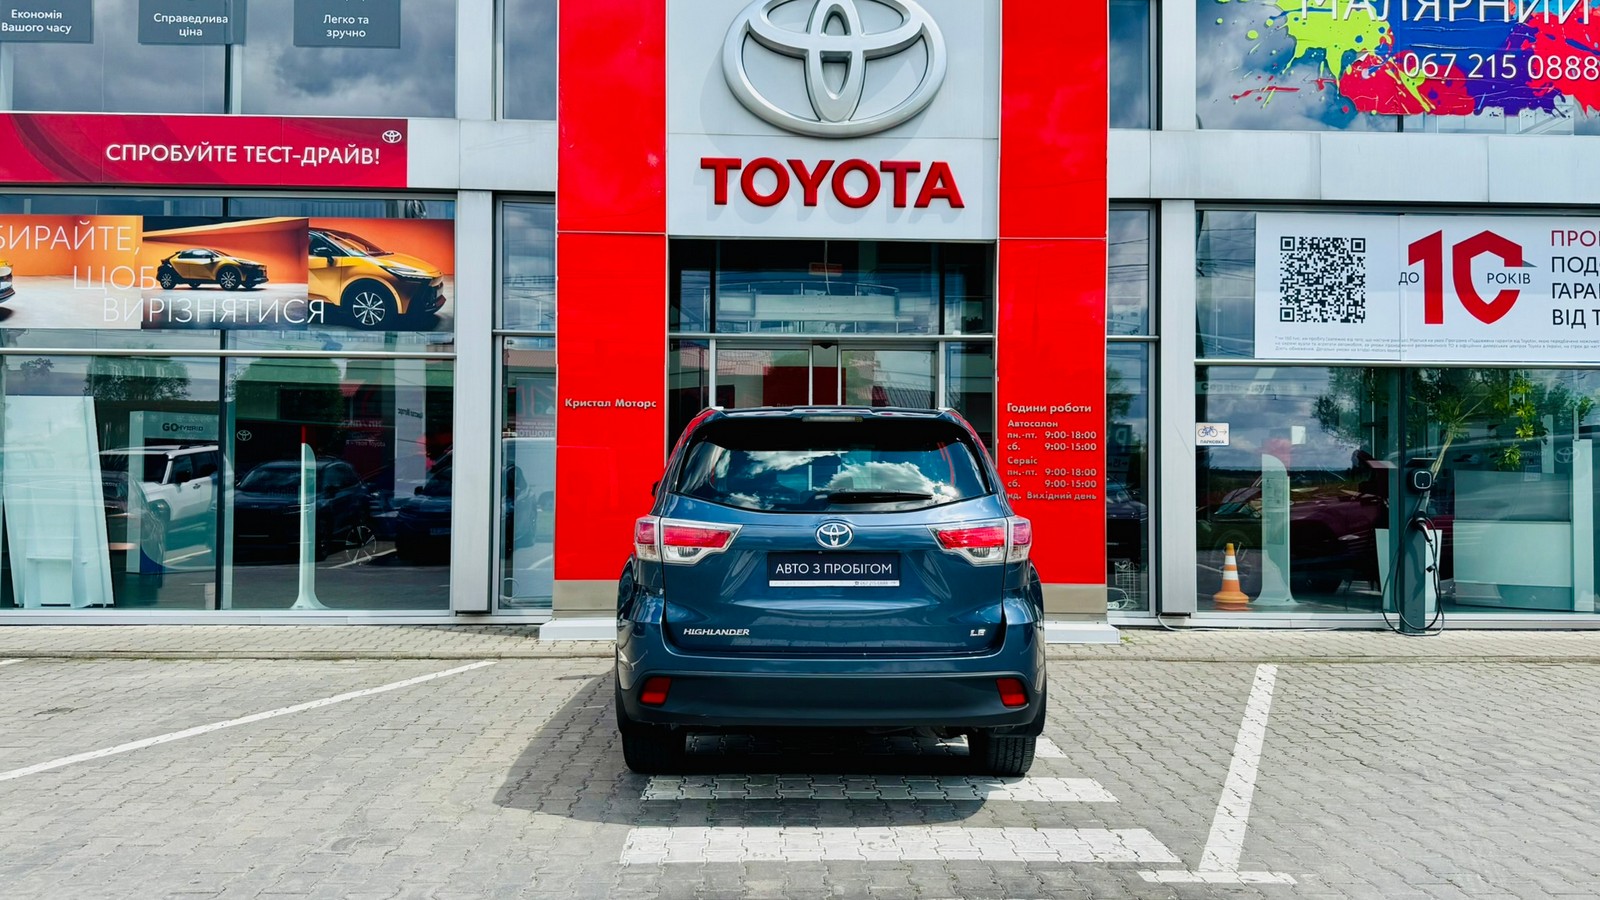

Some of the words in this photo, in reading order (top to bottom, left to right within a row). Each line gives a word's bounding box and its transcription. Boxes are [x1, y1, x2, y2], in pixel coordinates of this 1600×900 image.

[11, 9, 63, 20] Економія
[153, 12, 229, 25] Справедлива
[323, 14, 355, 25] Легко
[357, 16, 370, 25] та
[1, 22, 44, 33] Вашого
[47, 23, 72, 34] часу
[179, 27, 203, 38] ціна
[326, 29, 366, 39] зручно
[1402, 53, 1456, 79] 067
[1467, 54, 1517, 79] 215
[1527, 55, 1600, 81] 0888
[106, 141, 237, 163] СПРОБУЙТЕ
[243, 143, 380, 167] ТЕСТ-ДРАЙВ!
[700, 157, 965, 208] TOYOTA
[1551, 230, 1600, 247] ПРО
[1551, 256, 1600, 277] ПОД
[73, 265, 156, 294] ЩОБ
[1399, 272, 1420, 286] ДО
[1487, 272, 1530, 285] РОКІВ
[1551, 282, 1600, 299] ГАРА
[103, 298, 325, 324] ВИРІЗНЯТИСЯ
[1552, 308, 1586, 329] ВІД
[565, 398, 611, 409] Кристал
[615, 398, 657, 410] Моторс
[1007, 403, 1047, 413] Години
[1050, 403, 1092, 414] роботи
[1008, 419, 1058, 427] Автосалон
[1044, 431, 1097, 439] 9:00-18:00
[1007, 442, 1021, 450] сб.
[1044, 442, 1097, 450] 9:00-15:00
[1007, 456, 1038, 466] Сервіс
[1044, 468, 1097, 476] 9:00-18:00
[1007, 480, 1021, 488] сб.
[1044, 480, 1097, 488] 9:00-15:00
[1026, 492, 1072, 500] Вихідний
[775, 563, 810, 574] АВТО
[824, 563, 892, 574] ПРОБІГОМ
[683, 628, 750, 636] HIGHLANDER
[969, 629, 986, 637] LE
